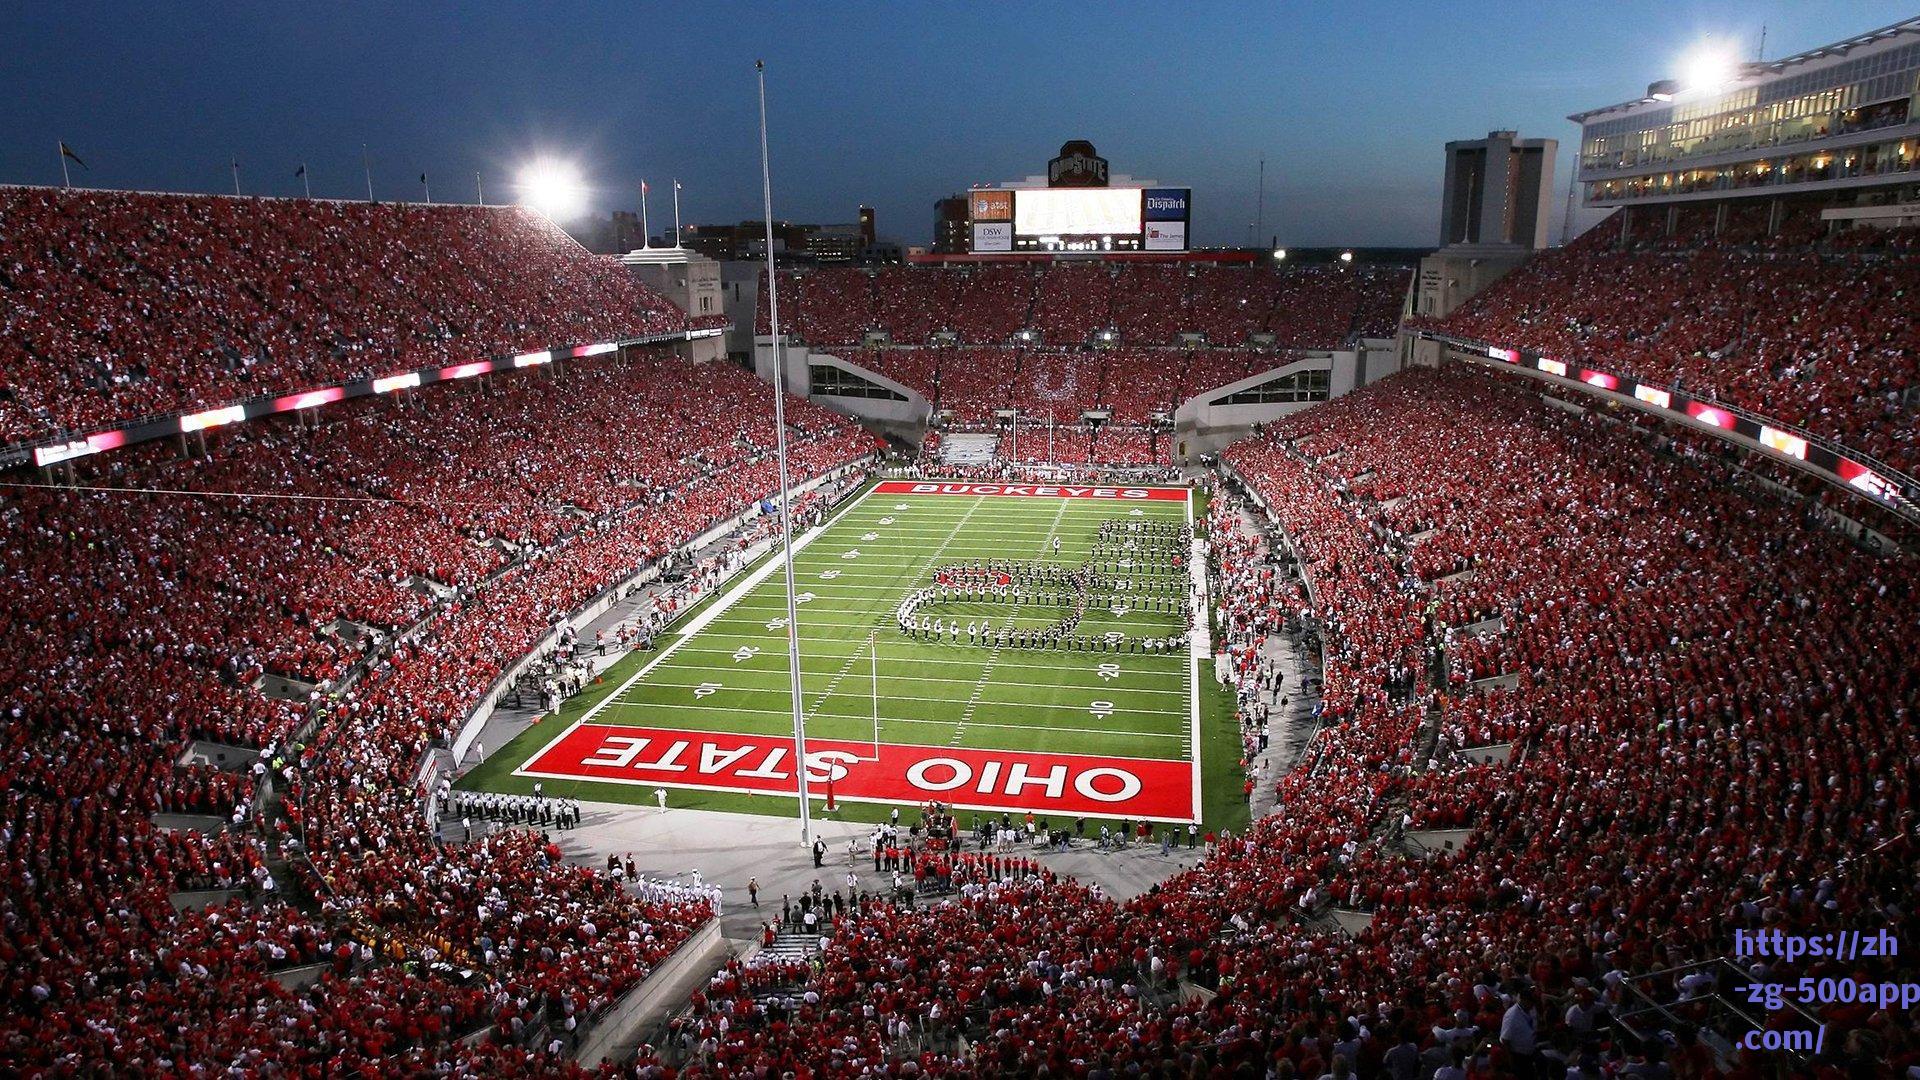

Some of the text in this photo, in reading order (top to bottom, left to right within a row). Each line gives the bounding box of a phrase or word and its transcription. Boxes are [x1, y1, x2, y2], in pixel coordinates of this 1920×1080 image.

[1147, 198, 1185, 211] Dispatch
[983, 228, 1002, 236] DSW
[911, 484, 1149, 498] BUCKEYES
[1089, 701, 1114, 715] 10
[580, 736, 1143, 802] OHIO STATE
